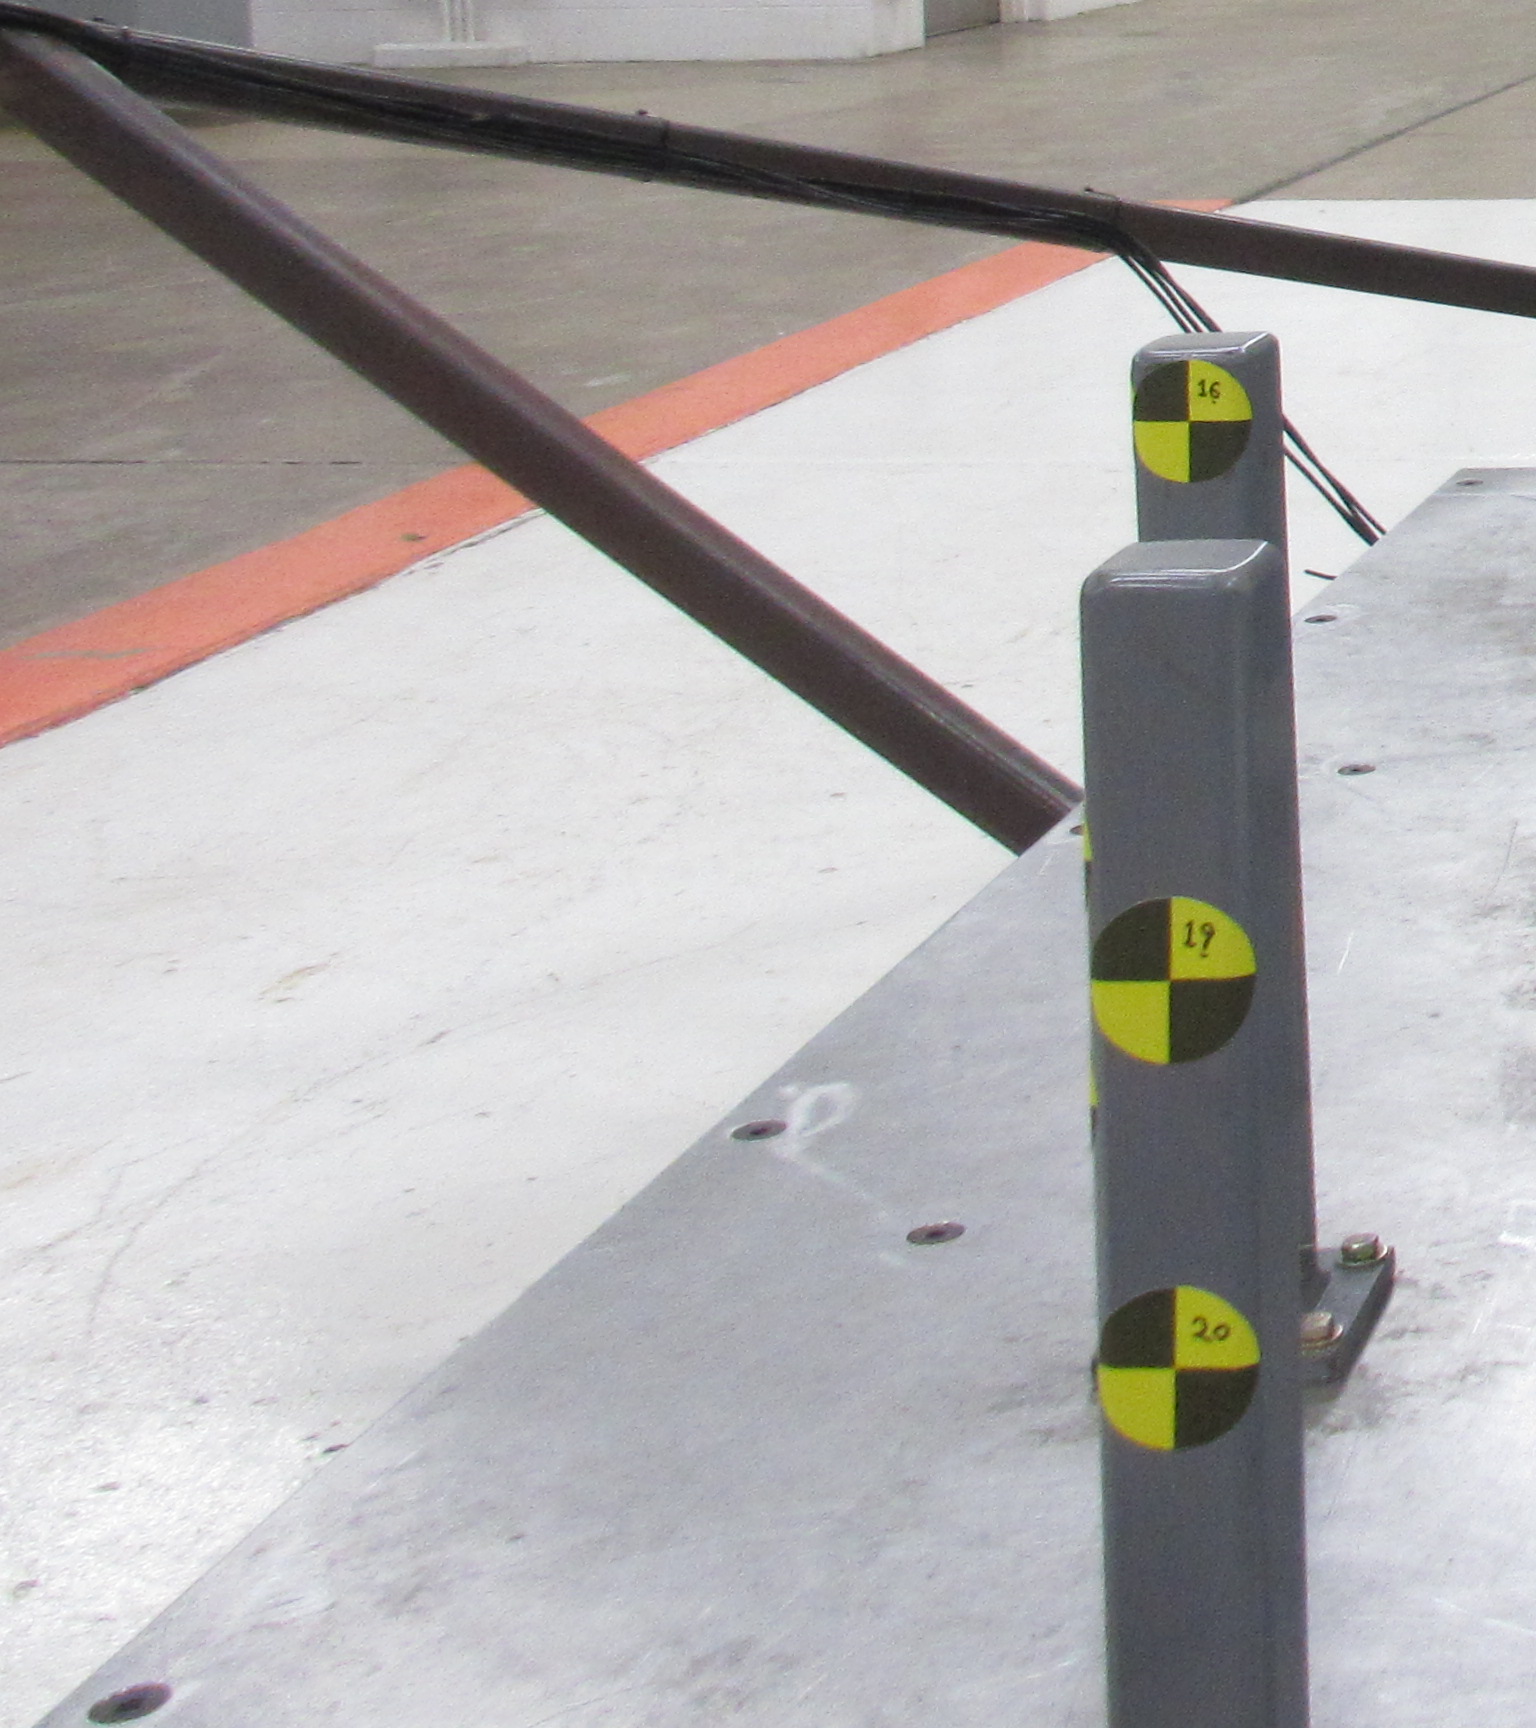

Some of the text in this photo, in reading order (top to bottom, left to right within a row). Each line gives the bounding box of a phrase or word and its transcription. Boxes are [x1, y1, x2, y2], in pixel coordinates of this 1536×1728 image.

[1197, 379, 1221, 401] 16
[1184, 919, 1216, 957] 19
[1192, 1315, 1231, 1343] 20
